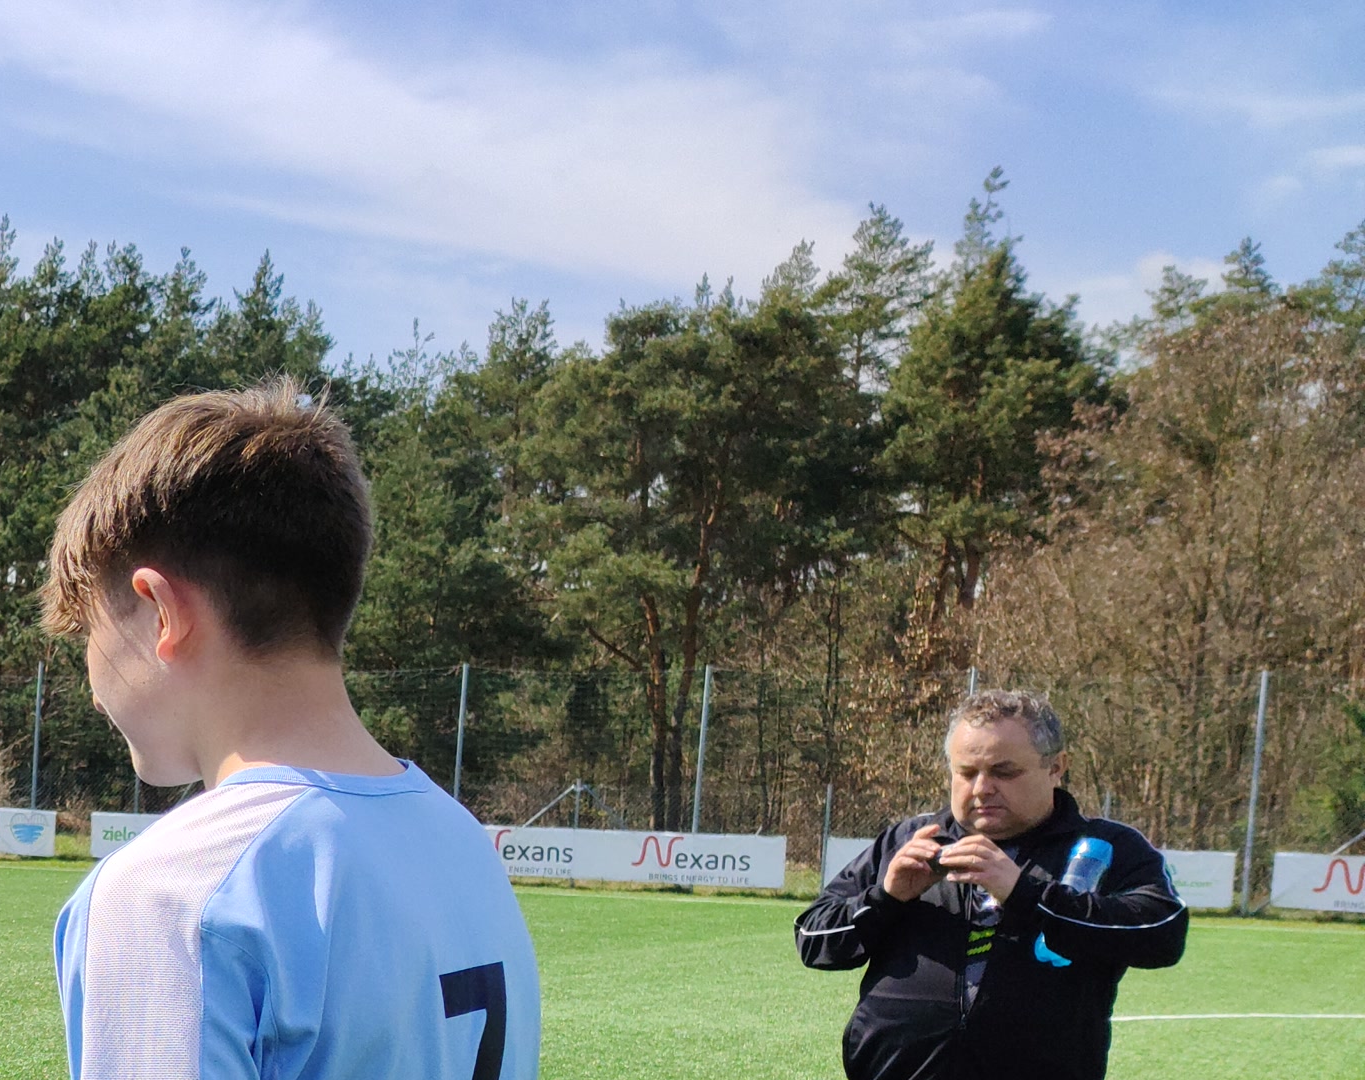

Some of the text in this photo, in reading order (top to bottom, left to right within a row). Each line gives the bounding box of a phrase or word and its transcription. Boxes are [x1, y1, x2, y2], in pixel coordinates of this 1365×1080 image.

[631, 835, 751, 871] Nexans
[509, 866, 572, 876] ENERGY TO LIFE
[648, 873, 749, 885] BRINGS ENERGY TO LIFE
